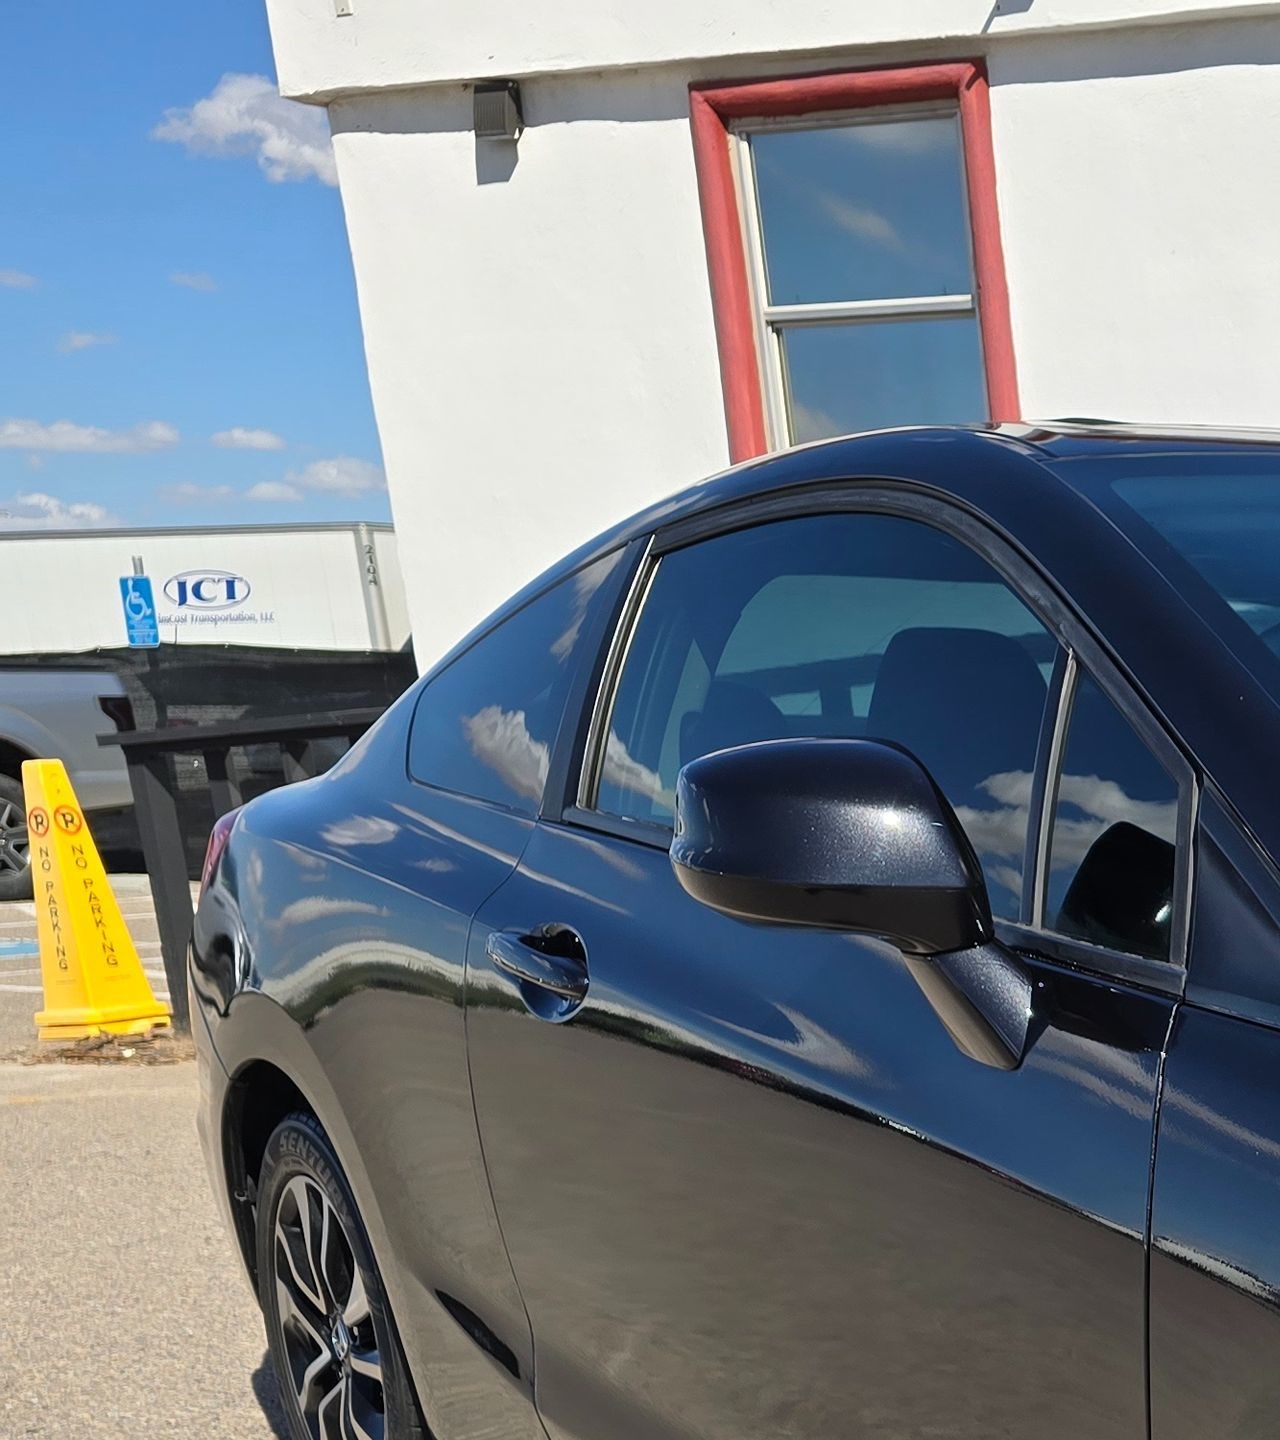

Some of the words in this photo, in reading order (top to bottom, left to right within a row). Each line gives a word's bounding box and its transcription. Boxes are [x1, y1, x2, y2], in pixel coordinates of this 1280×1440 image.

[177, 577, 244, 607] JCT
[39, 846, 51, 871] NO
[45, 880, 69, 970] PARKING
[71, 844, 88, 870] NO
[83, 878, 118, 966] PARKING
